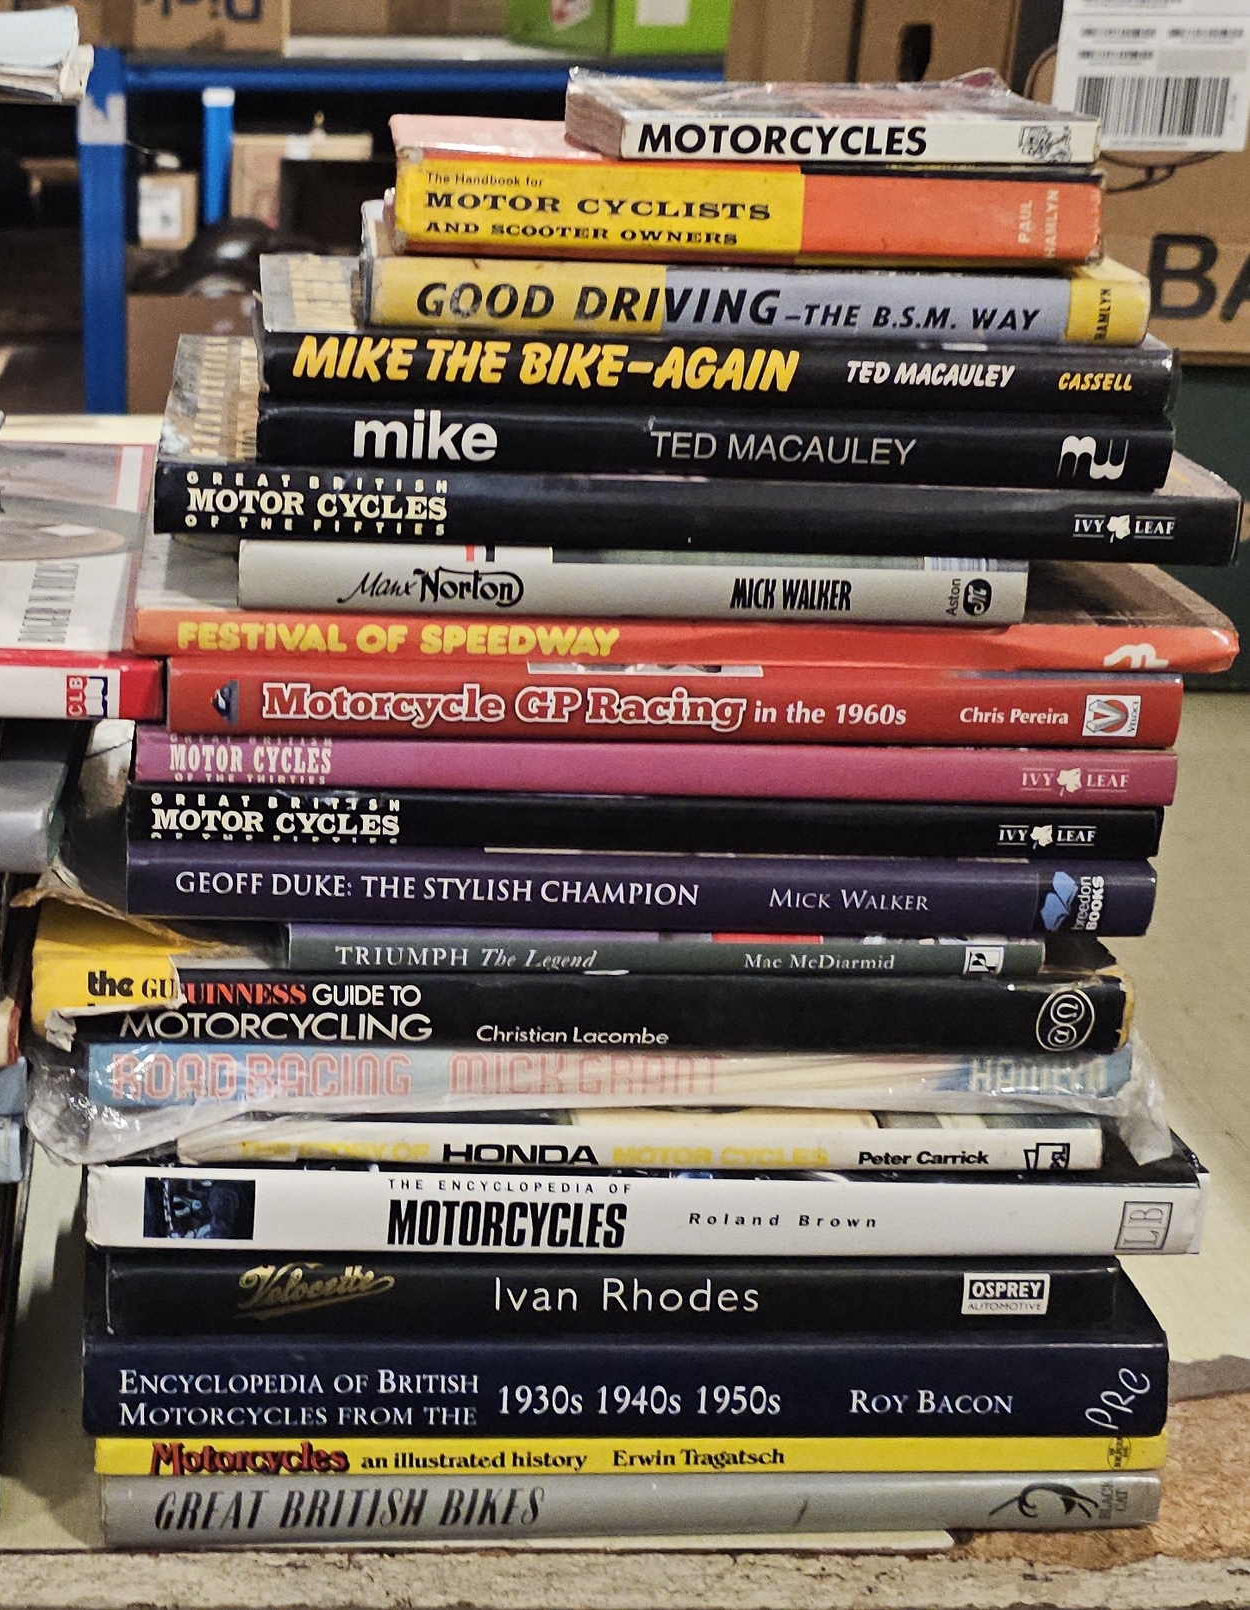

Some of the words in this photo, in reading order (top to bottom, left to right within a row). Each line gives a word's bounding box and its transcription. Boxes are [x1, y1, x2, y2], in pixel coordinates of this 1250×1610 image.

[637, 124, 927, 157] MOTORCYCLES
[426, 171, 449, 186] The
[454, 172, 520, 188] Handbook
[426, 192, 561, 213] MOTOR
[578, 197, 771, 221] CYCLISTS
[425, 221, 479, 235] AND
[490, 225, 608, 242] SCOOTER
[620, 229, 738, 246] OWNERS
[415, 282, 555, 322] GOOD
[874, 304, 957, 331] B.S.M.
[971, 307, 1041, 333] WAY
[292, 336, 418, 383] MIKE
[425, 339, 509, 385] THE
[846, 360, 892, 384] TED
[895, 361, 1016, 389] MACAULEY
[1059, 372, 1132, 391] CASSELL
[353, 408, 499, 461] mike
[186, 471, 291, 488] GREAT
[309, 475, 447, 494] BRITISH
[186, 487, 304, 516] MOTOR
[317, 494, 448, 521] CYCLES
[730, 579, 777, 611] MICK
[783, 579, 852, 611] WALKER
[946, 578, 961, 616] Aston
[178, 622, 348, 652] FESTIVAL
[356, 625, 407, 652] OF
[420, 625, 620, 657] SPEEDWAY
[68, 675, 84, 718] CLB
[262, 682, 504, 727] Motorcycle
[516, 687, 584, 724] GP
[586, 688, 747, 732] Racing
[786, 700, 824, 724] the
[836, 703, 906, 726] 1960s
[959, 706, 1005, 724] Chris
[1010, 707, 1068, 725] Pereira
[169, 744, 243, 773] MOTOR
[253, 746, 332, 775] CYCLES
[176, 871, 262, 896] GEOFF
[271, 874, 352, 897] DUKE:
[362, 876, 414, 899] THE
[423, 877, 532, 902] STYLISH
[540, 880, 699, 907] CHAMPION
[1071, 876, 1090, 931] breedon
[1086, 875, 1105, 931] BOOKS
[335, 946, 468, 967] TRIUMPH
[480, 948, 516, 968] The
[524, 949, 598, 972] Legend
[744, 953, 781, 970] Mac
[789, 953, 895, 970] McDiarmid
[87, 970, 134, 997] the
[312, 984, 383, 1006] GUIDE
[389, 985, 421, 1007] TO
[119, 1010, 433, 1042] MOTORCYCLING
[476, 1024, 567, 1044] Christian
[572, 1026, 669, 1045] Lacombe
[442, 1144, 599, 1165] HONDA
[858, 1151, 902, 1167] Peter
[908, 1151, 989, 1167] Carrick
[388, 1178, 424, 1191] THE
[438, 1179, 595, 1194] ENCYCLOPEDIA
[387, 1199, 628, 1248] MOTORCYCLES
[688, 1212, 780, 1228] Roland
[798, 1213, 877, 1229] Brown
[238, 1261, 395, 1308] Velocette
[494, 1277, 578, 1312] Ivan
[602, 1277, 759, 1312] Rhodes
[971, 1279, 1043, 1299] OSPREY
[333, 1374, 369, 1395] OF
[377, 1371, 479, 1395] BRITISH
[119, 1402, 327, 1427] MOTORCYCLES
[339, 1405, 414, 1427] FROM
[423, 1406, 477, 1427] THE
[499, 1384, 583, 1416] 1930s
[597, 1384, 681, 1416] 1940s
[697, 1385, 781, 1416] 1950s
[850, 1389, 909, 1416] ROY
[917, 1390, 1013, 1416] BACON
[150, 1441, 350, 1477] Motorcycles
[361, 1455, 387, 1469] an
[392, 1451, 506, 1470] illustrated
[512, 1451, 587, 1473] history
[612, 1448, 675, 1468] Erwin
[680, 1448, 785, 1470] Tragatsch
